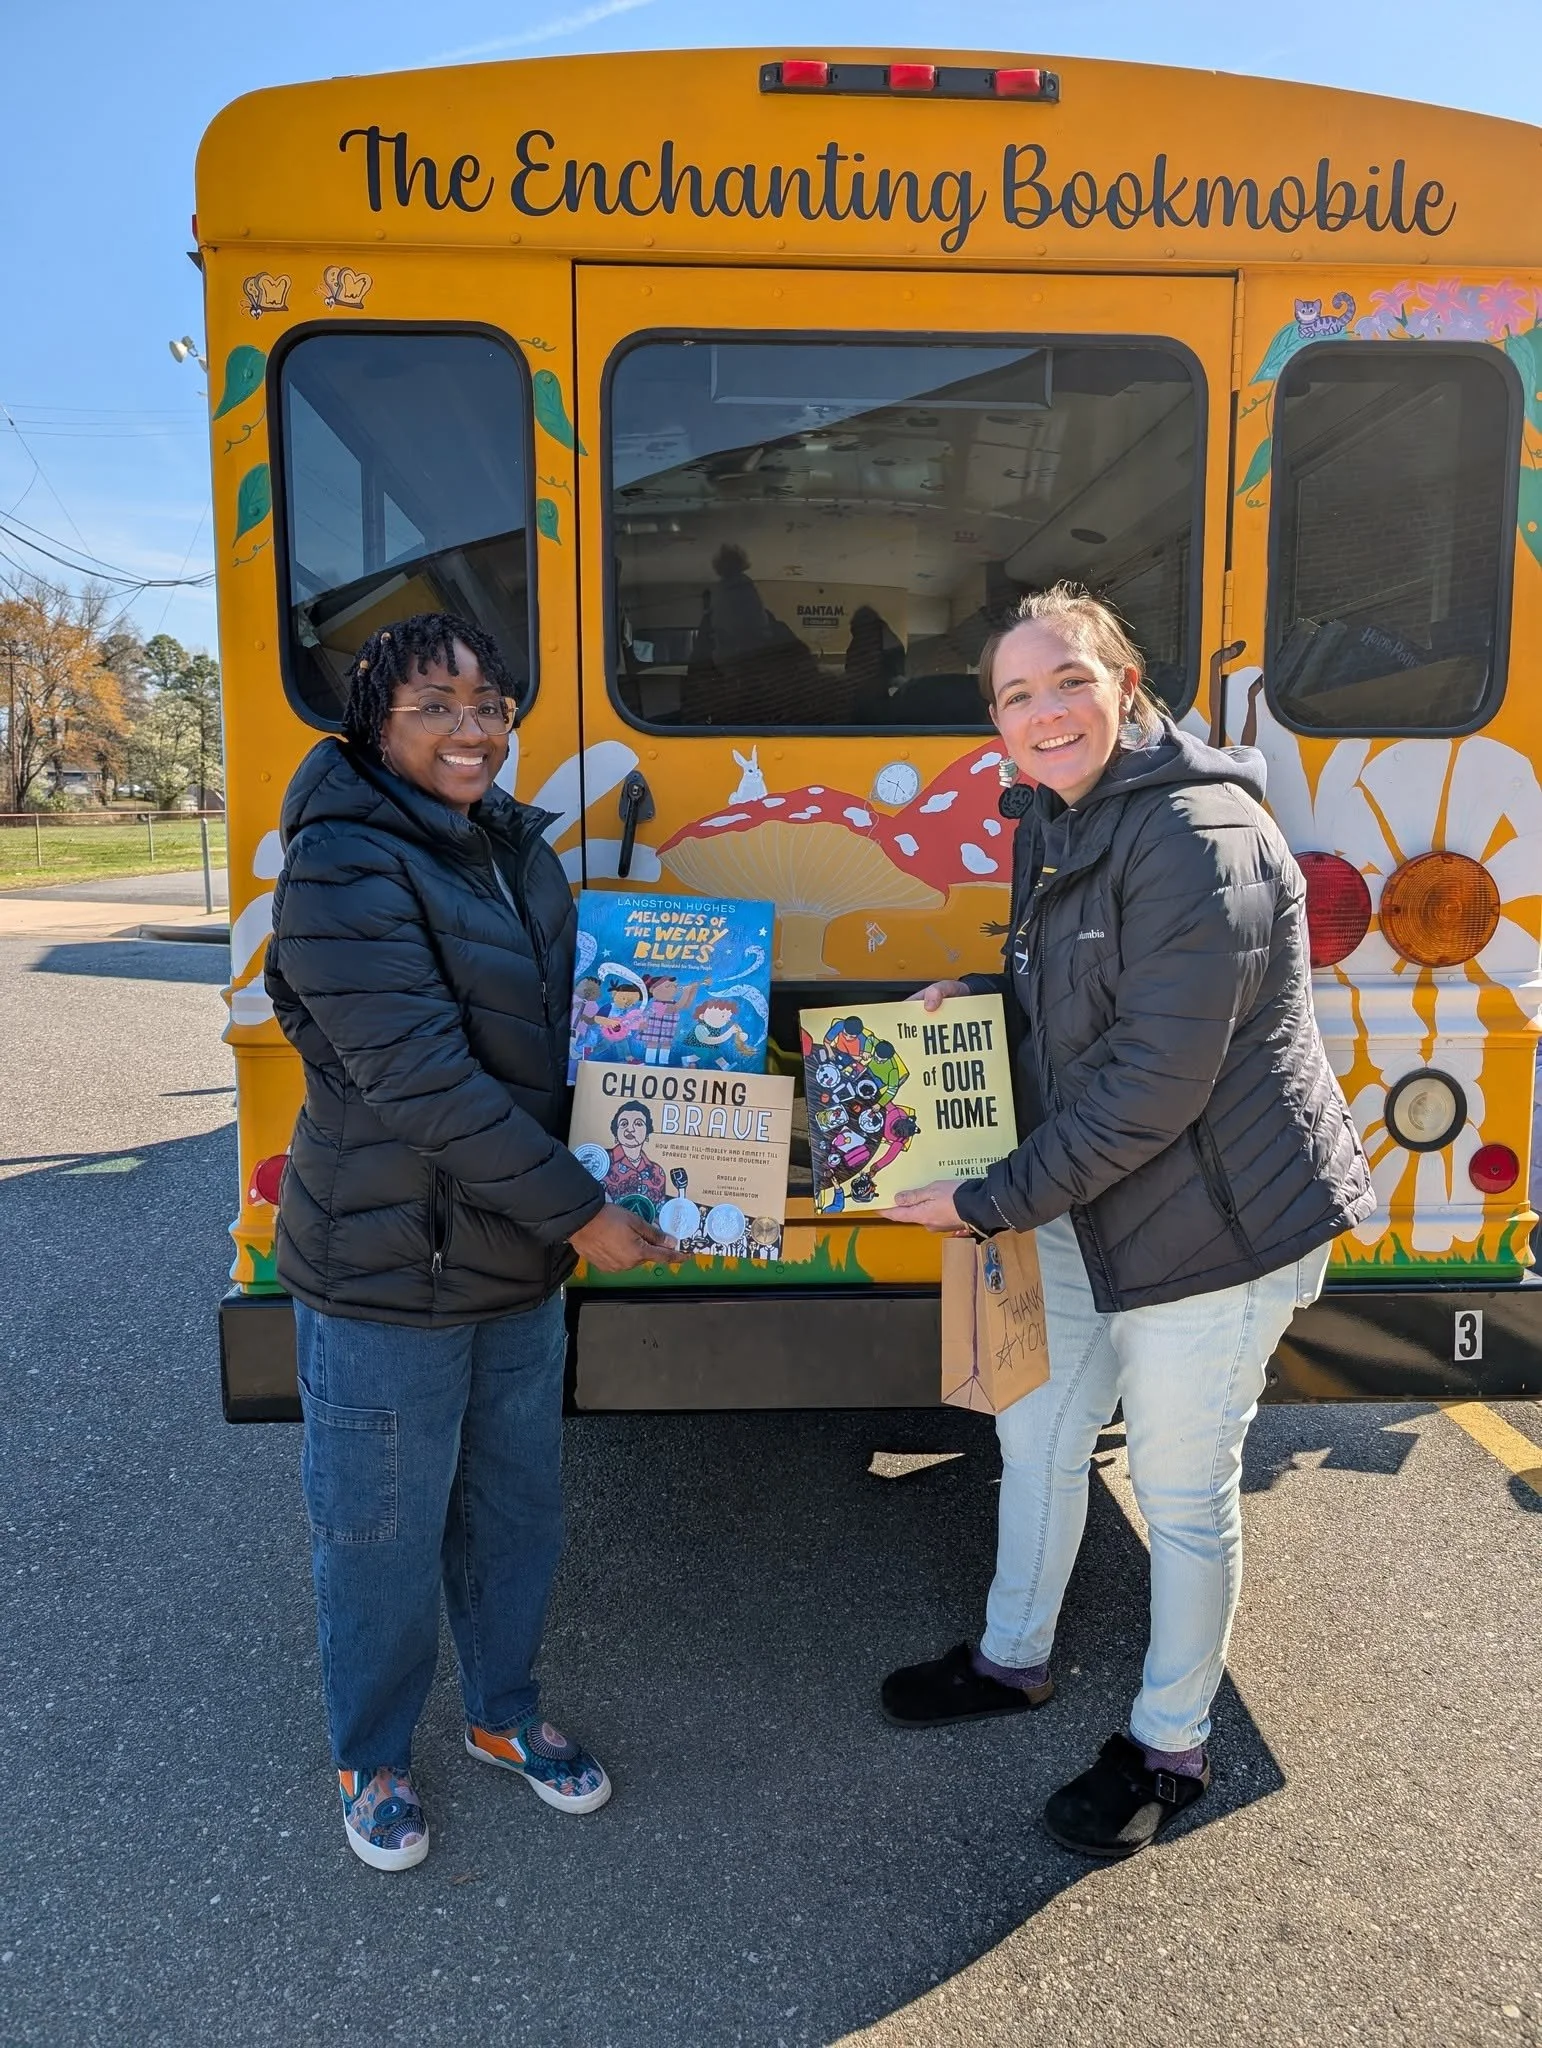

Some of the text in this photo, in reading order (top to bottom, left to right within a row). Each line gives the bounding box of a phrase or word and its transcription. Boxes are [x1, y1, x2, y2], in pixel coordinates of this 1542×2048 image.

[339, 126, 1456, 252] The Enchanting Bookmobile
[797, 605, 844, 616] BANTAM
[617, 899, 736, 913] LANGSTON HUGHES
[627, 911, 727, 928] MELODIES OF
[624, 926, 729, 945] THE WEARY
[1077, 929, 1105, 940] lumbia
[633, 941, 715, 963] BLUES
[897, 1020, 993, 1055] The HEART
[602, 1072, 747, 1106] CHOOSING
[923, 1060, 986, 1092] of OUR
[661, 1103, 772, 1142] BRAVE
[935, 1096, 998, 1130] HOME
[997, 1282, 1045, 1330] THANK
[1015, 1319, 1046, 1360] YOU
[1459, 1313, 1477, 1358] 3
